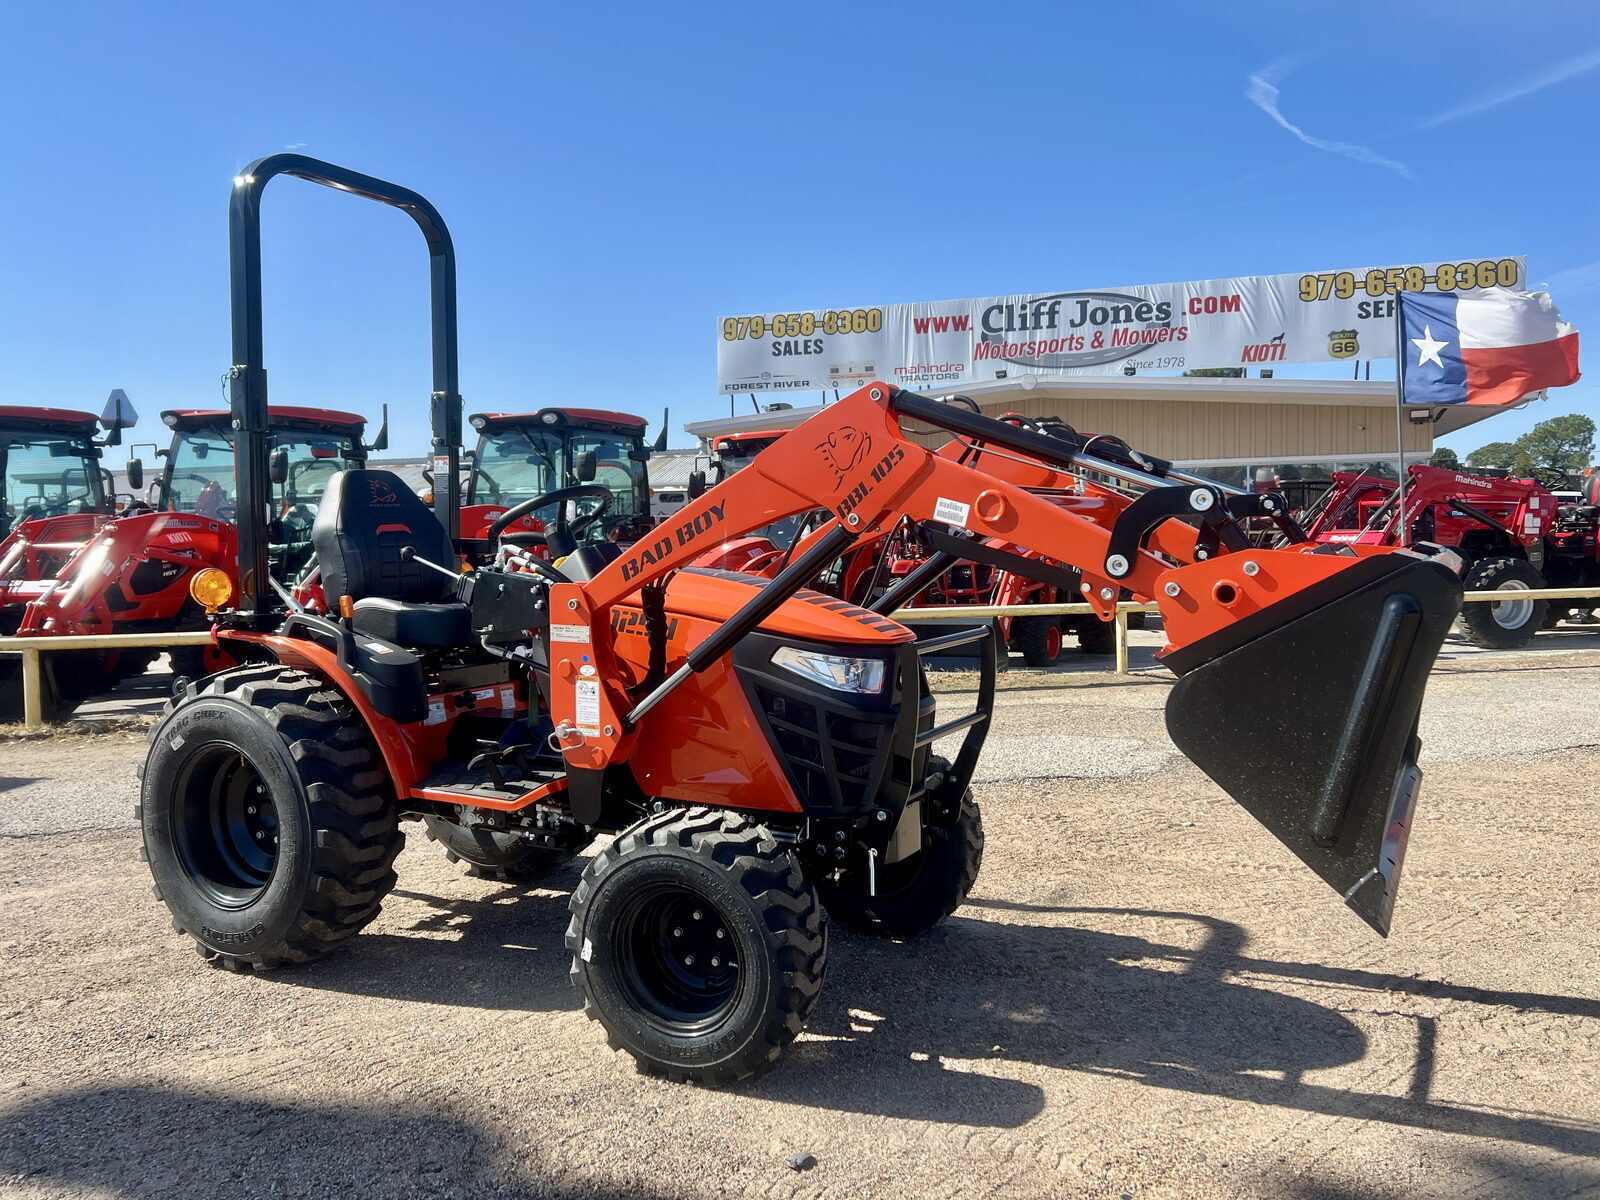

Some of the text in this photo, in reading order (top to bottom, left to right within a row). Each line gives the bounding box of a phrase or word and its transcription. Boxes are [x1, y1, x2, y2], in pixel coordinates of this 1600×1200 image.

[1299, 259, 1518, 302] 979-658-8360
[723, 308, 882, 342] 979-658-8360
[981, 300, 1062, 334] Cliff
[1069, 299, 1172, 329] Jones
[771, 338, 824, 357] SALES
[974, 326, 1189, 360] Motorsports & Mowers
[1241, 343, 1285, 362] KIOTI
[1332, 341, 1356, 353] 66
[894, 362, 965, 376] mahindra
[1126, 356, 1186, 369] Since 1978
[724, 379, 810, 391] FOREST RIVER
[899, 371, 960, 383] TRACTORS
[836, 444, 905, 520] BBL 105
[166, 531, 193, 544] KIOTI
[621, 498, 726, 583] BAD BOY
